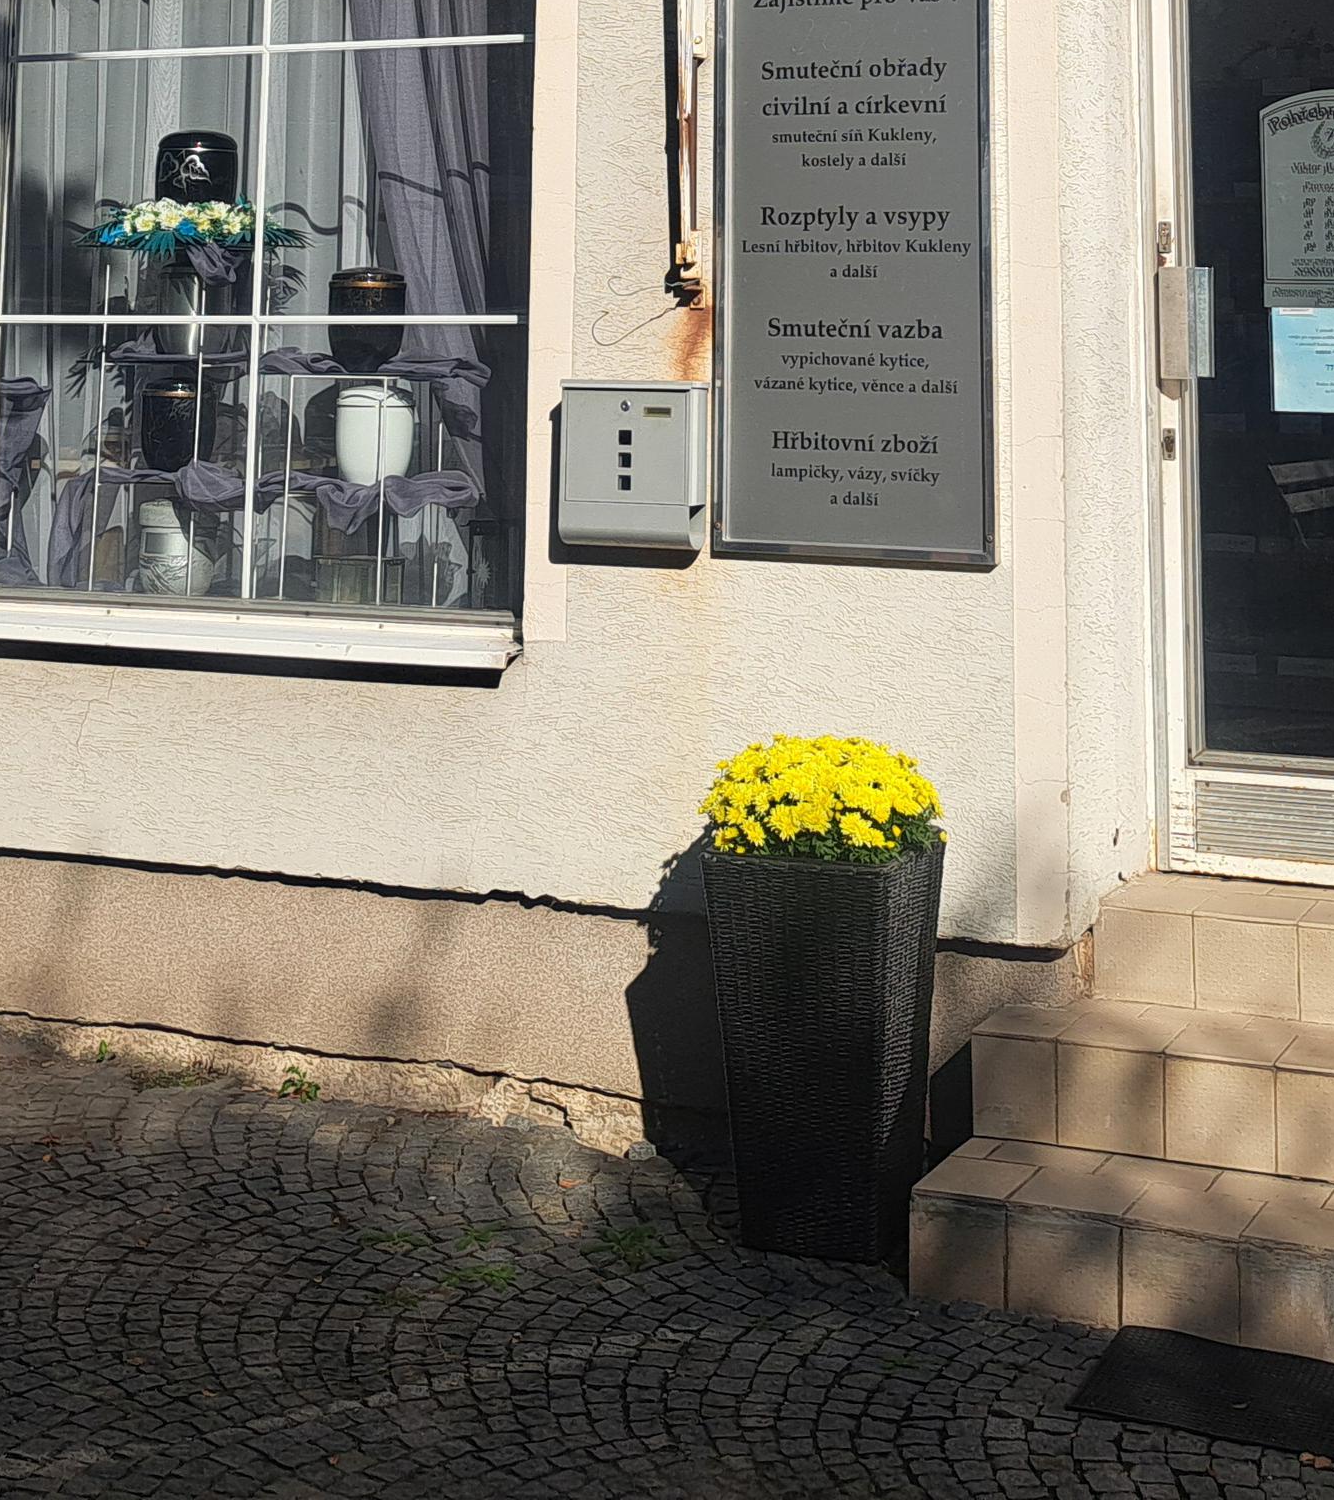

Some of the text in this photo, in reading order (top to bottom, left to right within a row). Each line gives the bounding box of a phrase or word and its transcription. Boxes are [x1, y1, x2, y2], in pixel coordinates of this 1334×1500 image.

[761, 56, 948, 82] Smuteční obřady
[762, 94, 948, 117] civilní a církevní
[772, 127, 938, 145] smuteční síň Kukleny,
[802, 152, 907, 171] kostely a další
[760, 205, 951, 231] Rozptyly a vsypy
[742, 238, 972, 257] Lesní hřbitov, hřbitov Kukleny
[829, 264, 878, 279] a další
[767, 317, 944, 340] Smuteční vazba
[781, 352, 930, 371] vypichované kytice,
[754, 376, 959, 395] vázané kytice, věnce a další
[771, 429, 939, 454] Hřbitovní zboží
[770, 462, 941, 487] lampičky, vázy, svíčky
[829, 491, 879, 506] a další
